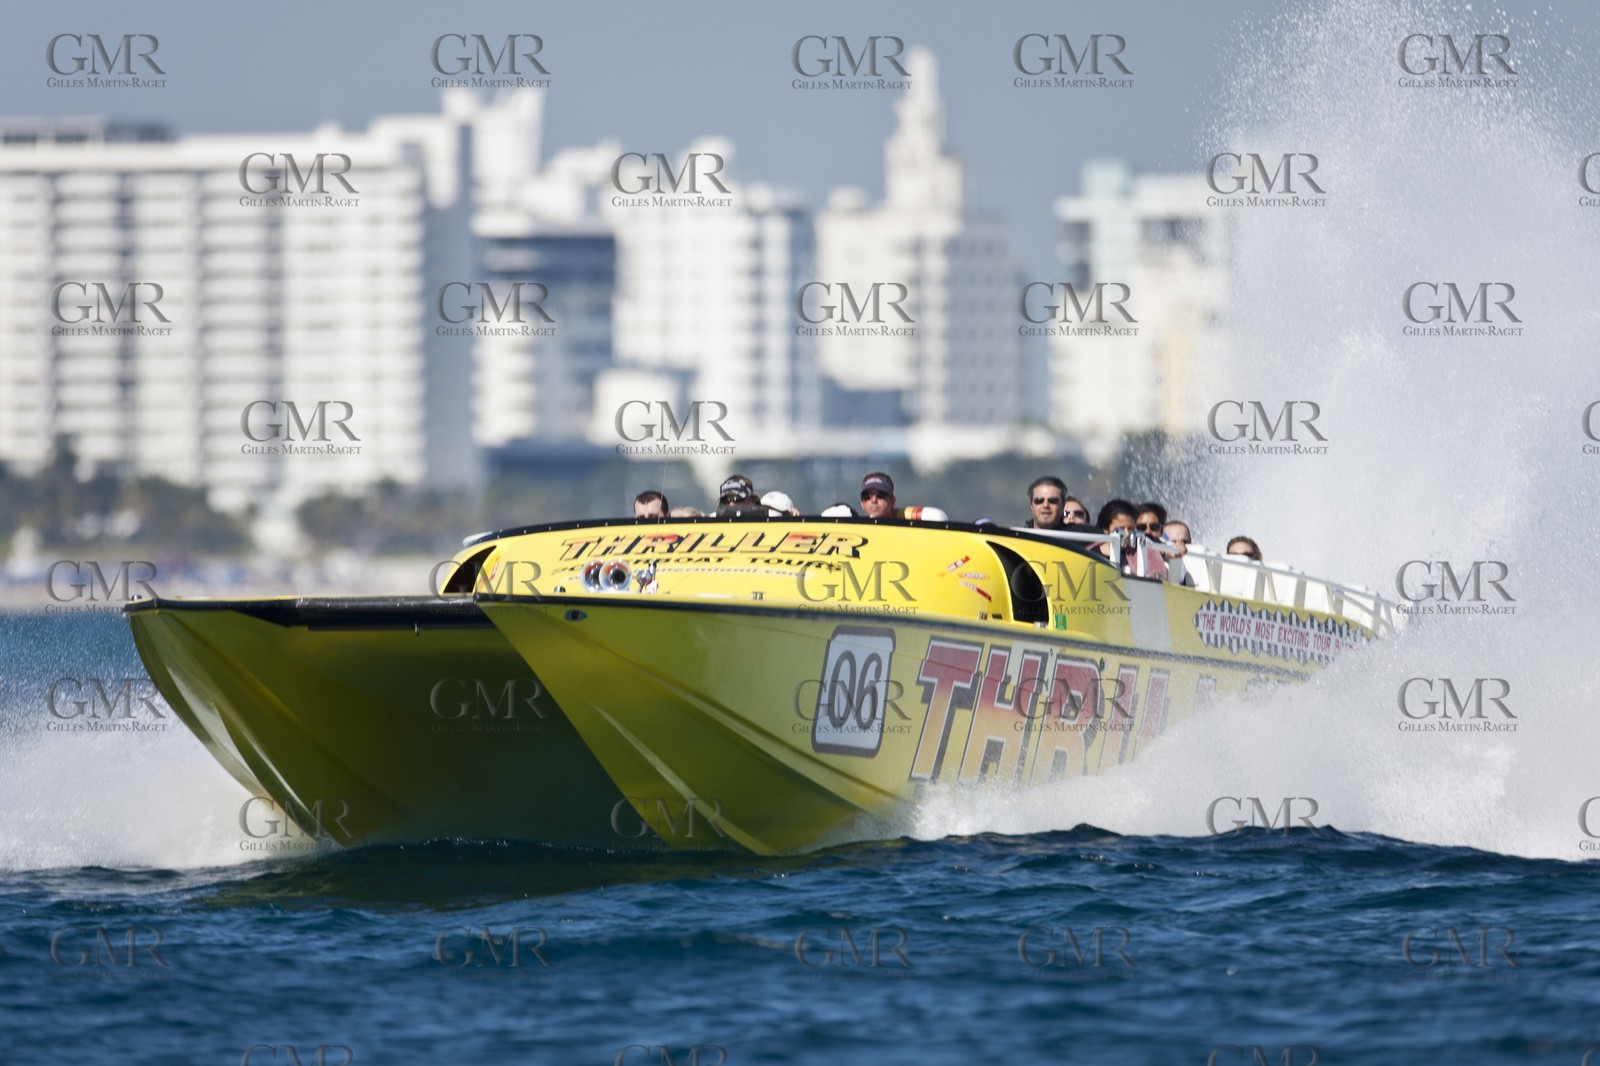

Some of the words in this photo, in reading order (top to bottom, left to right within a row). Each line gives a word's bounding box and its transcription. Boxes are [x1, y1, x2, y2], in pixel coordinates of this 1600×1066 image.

[559, 531, 869, 561] THRILLER
[1254, 620, 1275, 641] MOST
[828, 650, 883, 728] 06
